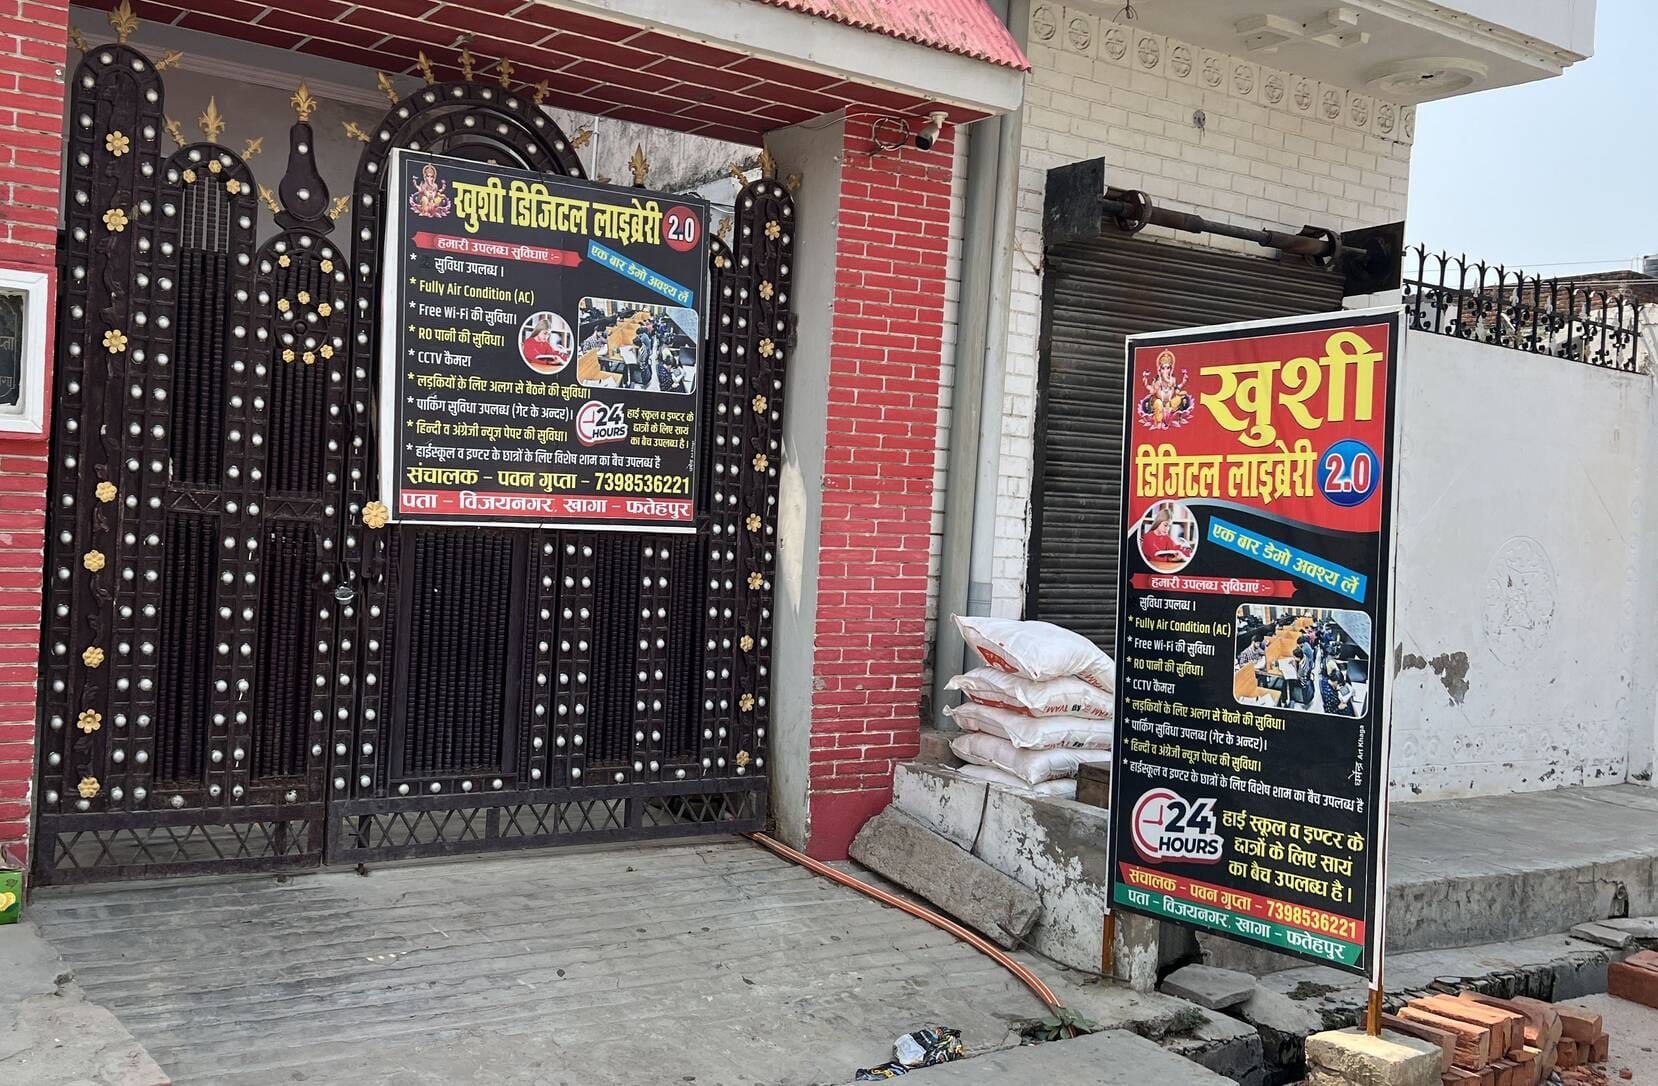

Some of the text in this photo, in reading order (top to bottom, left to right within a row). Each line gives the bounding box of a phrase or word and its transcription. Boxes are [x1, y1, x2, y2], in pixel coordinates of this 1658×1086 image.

[452, 177, 695, 246] खुशी डिजिटल लाइब्रेरी 2.0
[434, 256, 498, 276] सुविधा उपलब्ध
[420, 280, 534, 306] Fully Air Condition (AC)
[419, 304, 442, 317] Free
[444, 306, 469, 320] Wi-Fi
[470, 306, 484, 321] की
[419, 327, 432, 340] RO
[434, 328, 457, 342] पानी
[457, 329, 471, 344] की
[418, 350, 472, 367] CCTV कैमरा
[417, 373, 457, 390] लड़कियों
[457, 375, 467, 391] के
[468, 376, 488, 391] लिए
[489, 381, 514, 393] अलग
[514, 379, 525, 394] से
[525, 380, 546, 396] बैठने
[547, 382, 560, 397] की
[1200, 332, 1383, 447] खुशी
[447, 398, 477, 416] सुविधा
[478, 403, 510, 416] उपलब्ध
[530, 403, 540, 418] के
[594, 402, 625, 427] 24
[416, 419, 442, 435] हिन्दी
[452, 422, 479, 437] अंग्रेजी
[480, 426, 502, 442] न्यूज
[503, 424, 522, 439] पेपर
[523, 426, 536, 440] की
[592, 426, 626, 439] HOURS
[415, 443, 661, 469] हाईस्कूल इण्टर छात्रों लिए विशेष शाम बैच उपलब्ध है
[407, 462, 689, 494] संचालक पवन गुप्ता 7398536221
[1136, 439, 1371, 504] डिजिटल लाइब्रेरी 2.0
[401, 493, 438, 508] पता
[563, 499, 608, 513] खागा
[626, 498, 691, 519] फतेहपुर
[1213, 524, 1359, 593] एक बार डेमो अवश्य लें
[1139, 595, 1191, 611] सुविधा उपलब्ध
[1135, 617, 1231, 638] Fully Air Condition (AC)
[1134, 638, 1152, 649] Free
[1154, 640, 1173, 651] Wi-Fi
[1175, 639, 1186, 653] की
[1134, 658, 1144, 669] RO
[1146, 658, 1163, 671] पानी
[1164, 659, 1175, 672] की
[1133, 678, 1175, 694] CCTV कैमरा
[1132, 698, 1163, 713] लड़कियों
[1162, 701, 1171, 714] के
[1172, 702, 1188, 717] लिए
[1190, 707, 1211, 720] अलग
[1212, 707, 1221, 721] से
[1221, 708, 1241, 724] बैठने
[1242, 711, 1254, 726] की
[1155, 722, 1179, 738] सुविधा
[1180, 727, 1207, 741] उपलब्ध
[1225, 731, 1235, 745] के
[1131, 738, 1150, 753] हिन्दी
[1159, 744, 1180, 758] अंग्रेजी
[1182, 749, 1200, 764] न्यूज
[1201, 749, 1218, 765] पेपर
[1219, 752, 1231, 767] की
[1130, 760, 1364, 813] हाईस्कूल इण्टर छात्रों लिए विशेष शाम बैच उपलब्ध है
[1164, 800, 1213, 835] 24
[1223, 810, 1365, 851] हाई स्कूल इण्टर के
[1158, 836, 1219, 855] HOURS
[1269, 841, 1285, 860] के
[1288, 843, 1317, 867] लिए
[1320, 855, 1353, 877] सायं
[1229, 860, 1248, 878] का
[1250, 861, 1272, 883] बैच
[1331, 879, 1344, 902] है
[1129, 866, 1356, 939] संचालक पवन गुप्ता 7398536221
[1128, 890, 1150, 905] पता
[1236, 917, 1271, 937] खागा
[1287, 930, 1345, 959] फतेहपुर
